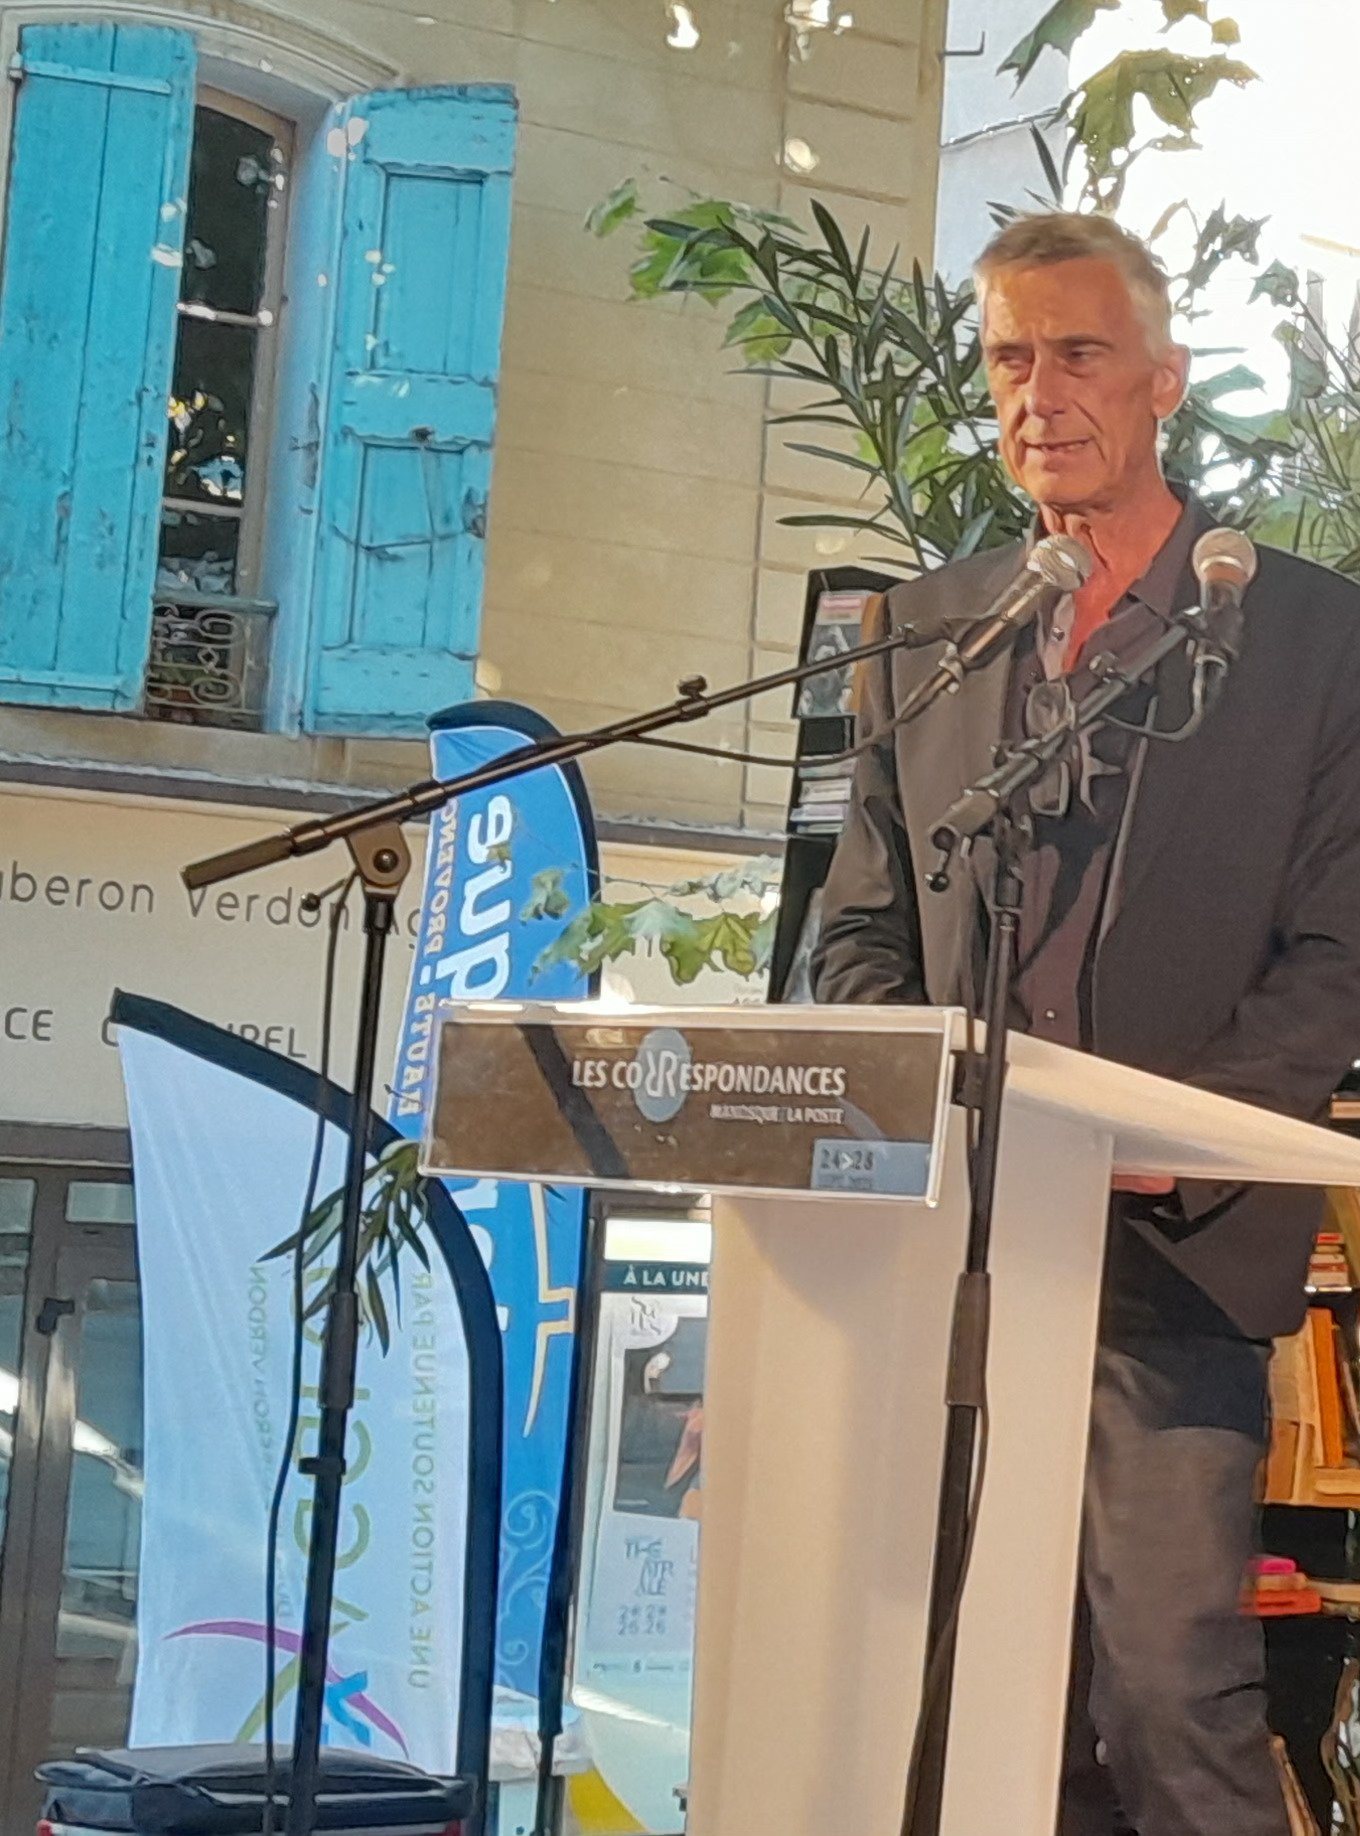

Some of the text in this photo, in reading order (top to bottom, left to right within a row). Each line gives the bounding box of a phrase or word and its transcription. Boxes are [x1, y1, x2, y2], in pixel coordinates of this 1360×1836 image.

[0, 861, 154, 914] beron
[572, 1059, 607, 1088] LES
[642, 1270, 666, 1287] LA
